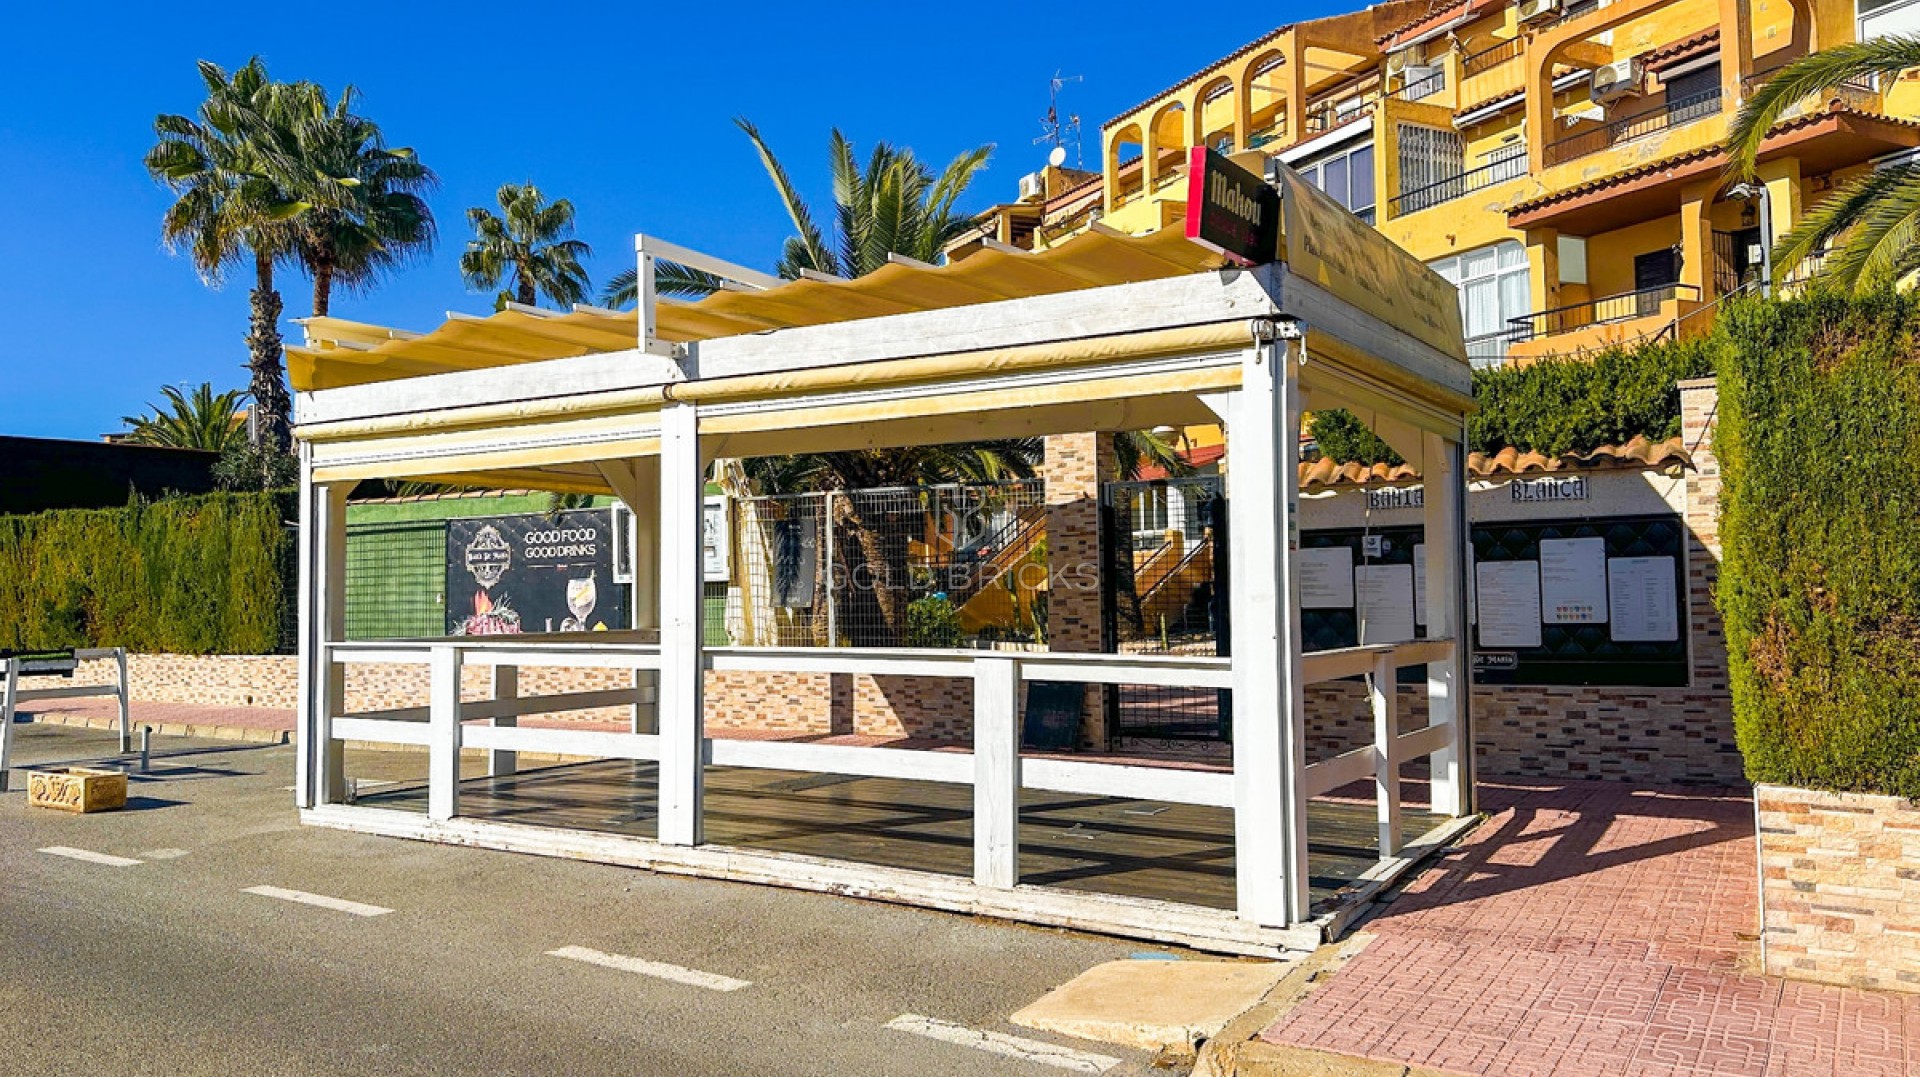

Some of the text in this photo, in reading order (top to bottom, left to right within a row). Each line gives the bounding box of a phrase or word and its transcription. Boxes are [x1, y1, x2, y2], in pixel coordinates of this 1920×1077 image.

[1211, 170, 1262, 226] Mahou
[1511, 478, 1584, 500] BLANCA
[525, 528, 596, 544] GOOD FOOD
[525, 545, 556, 558] GOOD
[557, 543, 596, 557] DRINKS
